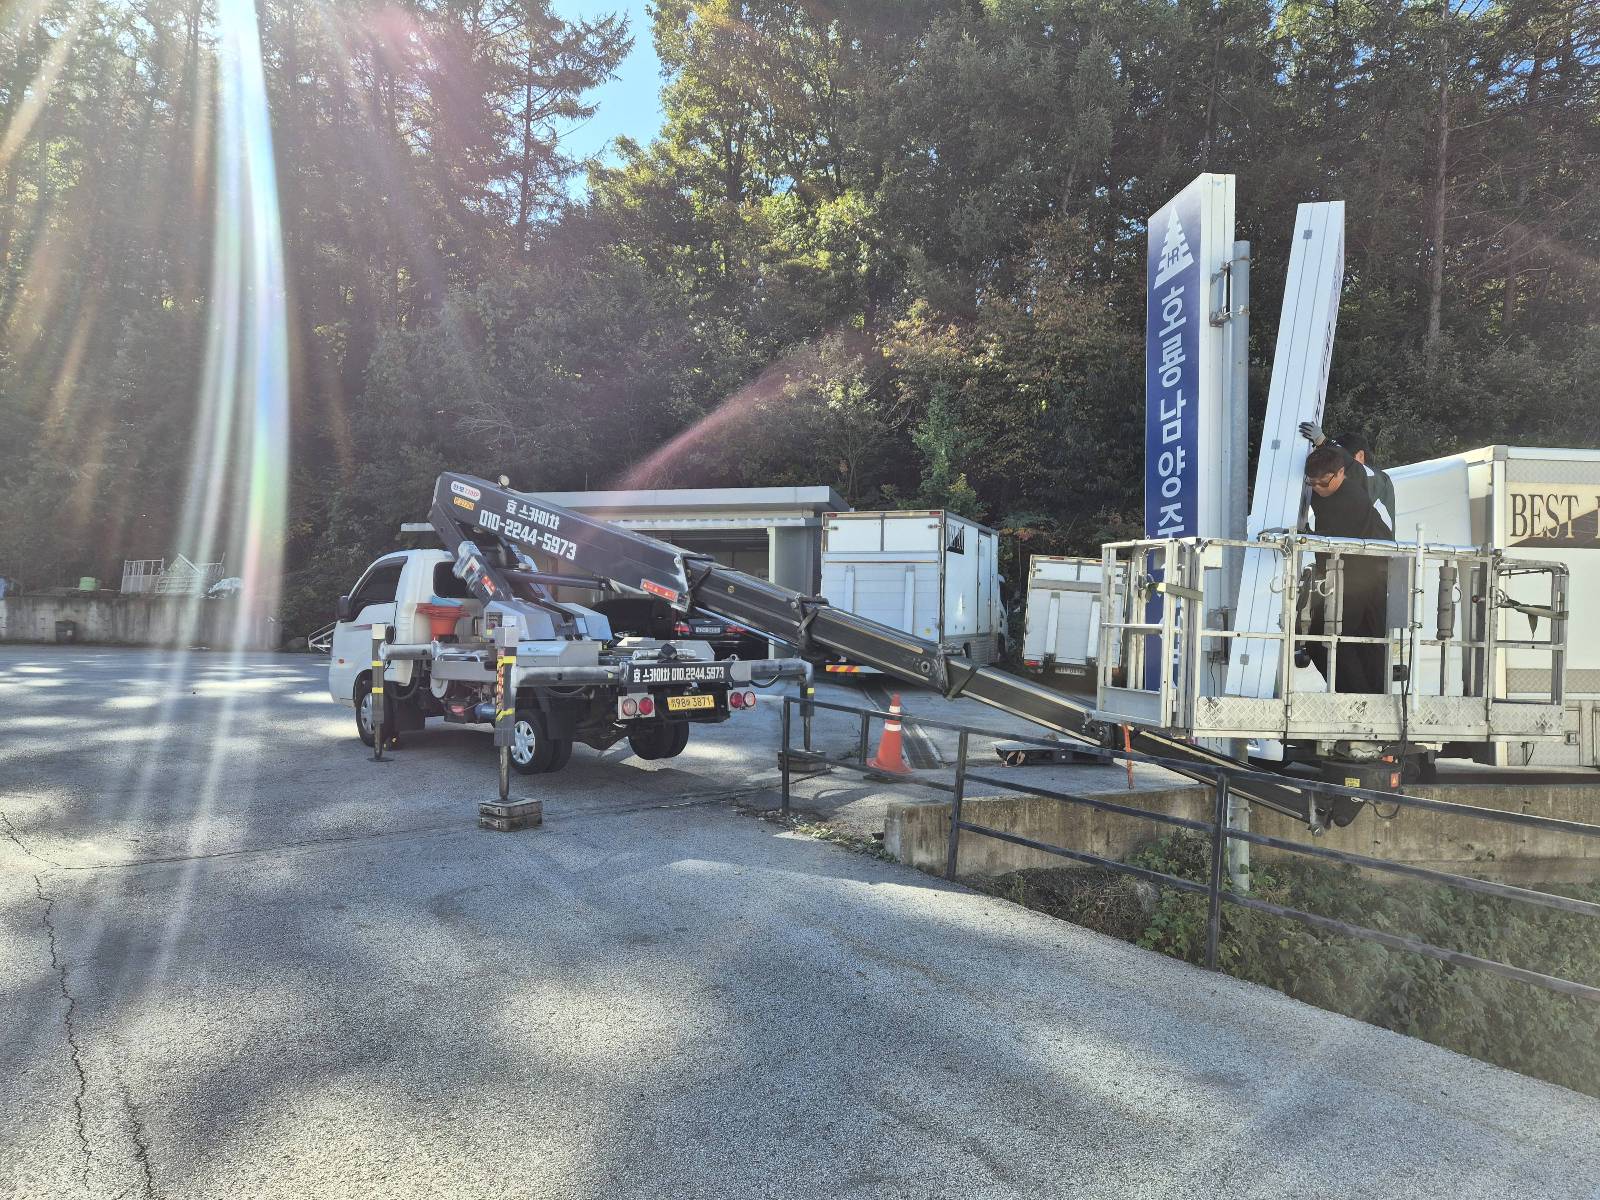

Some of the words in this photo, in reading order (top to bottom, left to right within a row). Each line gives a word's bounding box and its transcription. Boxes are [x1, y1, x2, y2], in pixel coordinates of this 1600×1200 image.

[506, 500, 517, 514] 효
[518, 504, 560, 530] 스카이차
[1510, 494, 1579, 538] BEST
[479, 509, 577, 561] 010-2244-5973
[633, 668, 641, 682] 효
[642, 667, 670, 682] 스카이차
[671, 667, 724, 681] 010.2244.5973
